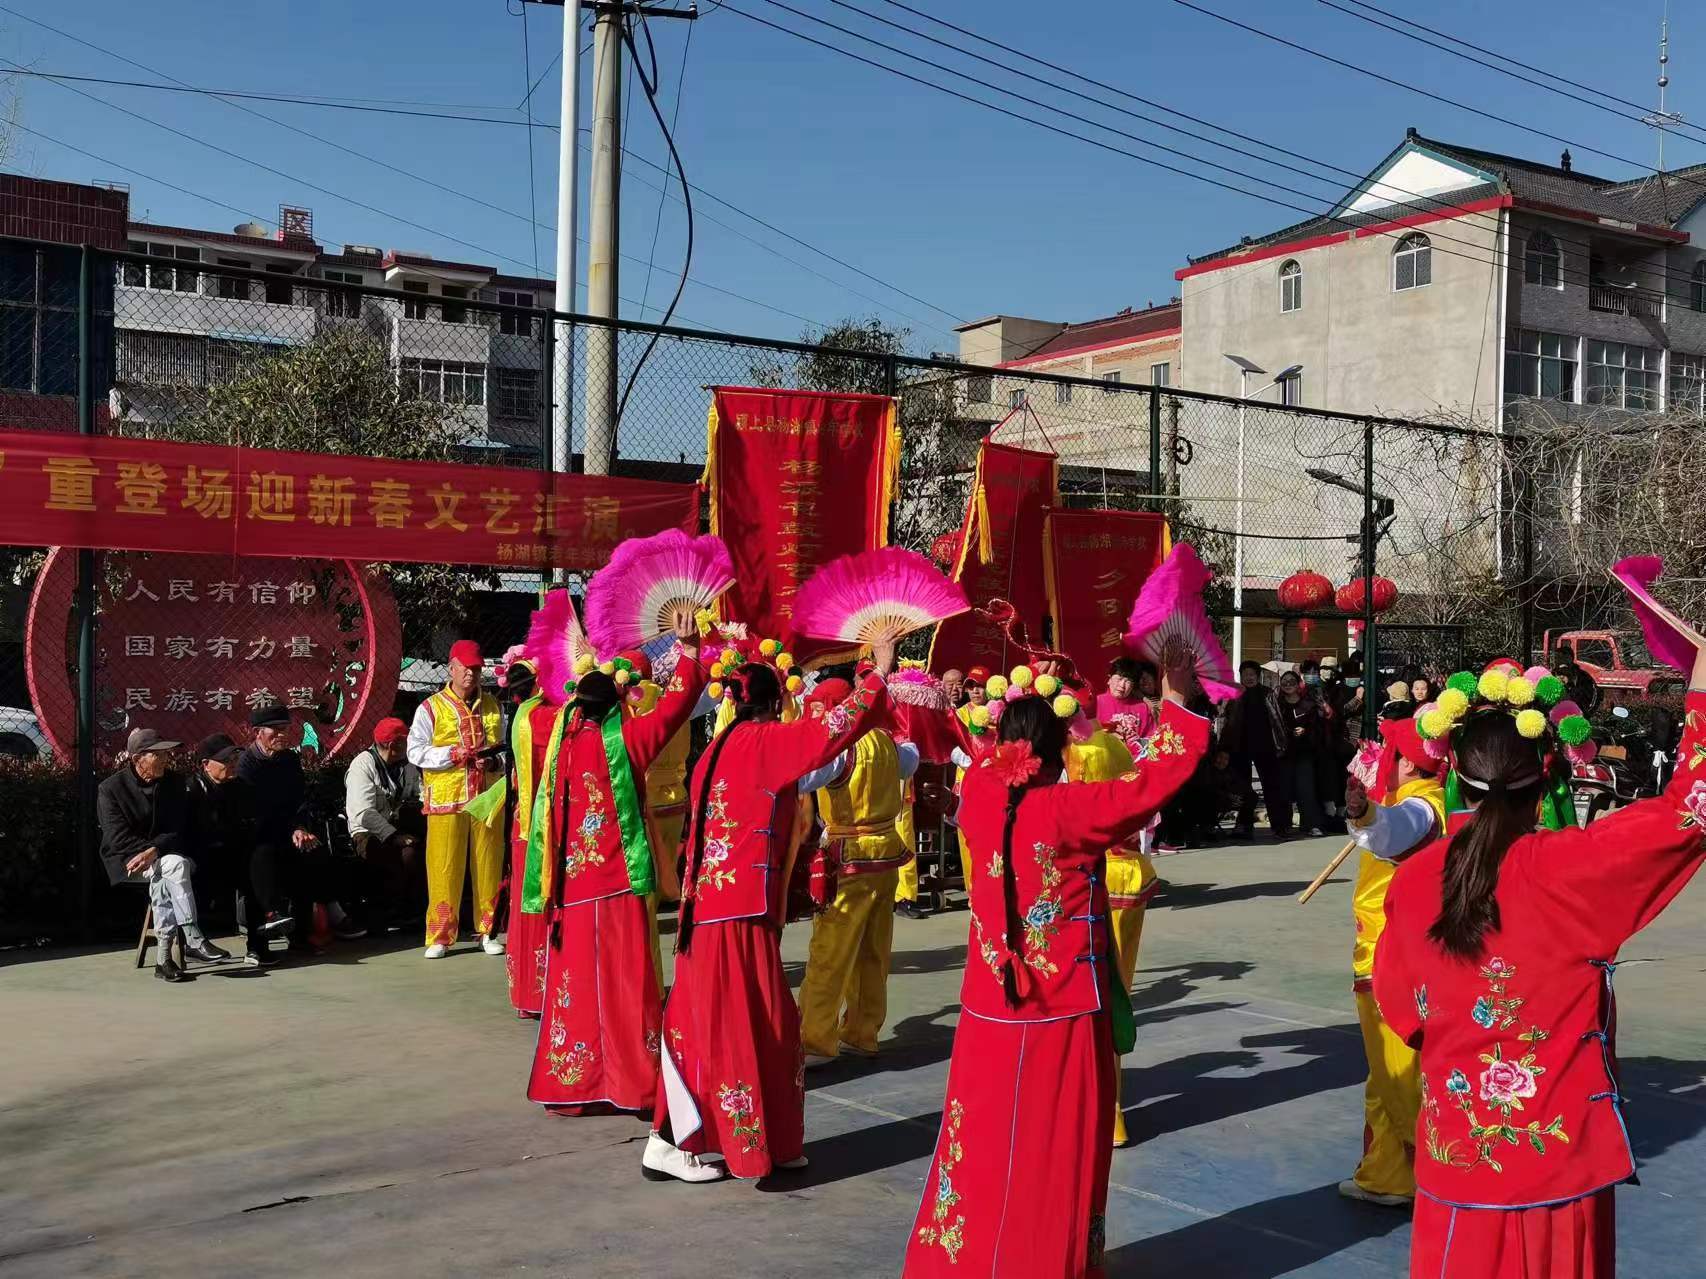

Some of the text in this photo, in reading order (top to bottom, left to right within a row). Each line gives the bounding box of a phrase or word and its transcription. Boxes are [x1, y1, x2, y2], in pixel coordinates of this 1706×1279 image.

[0, 451, 636, 541] 重登场迎新春文艺汇演。
[125, 578, 318, 605] 人民有信仰
[125, 634, 319, 661] 国家有力量
[125, 686, 320, 713] 民族有希望
